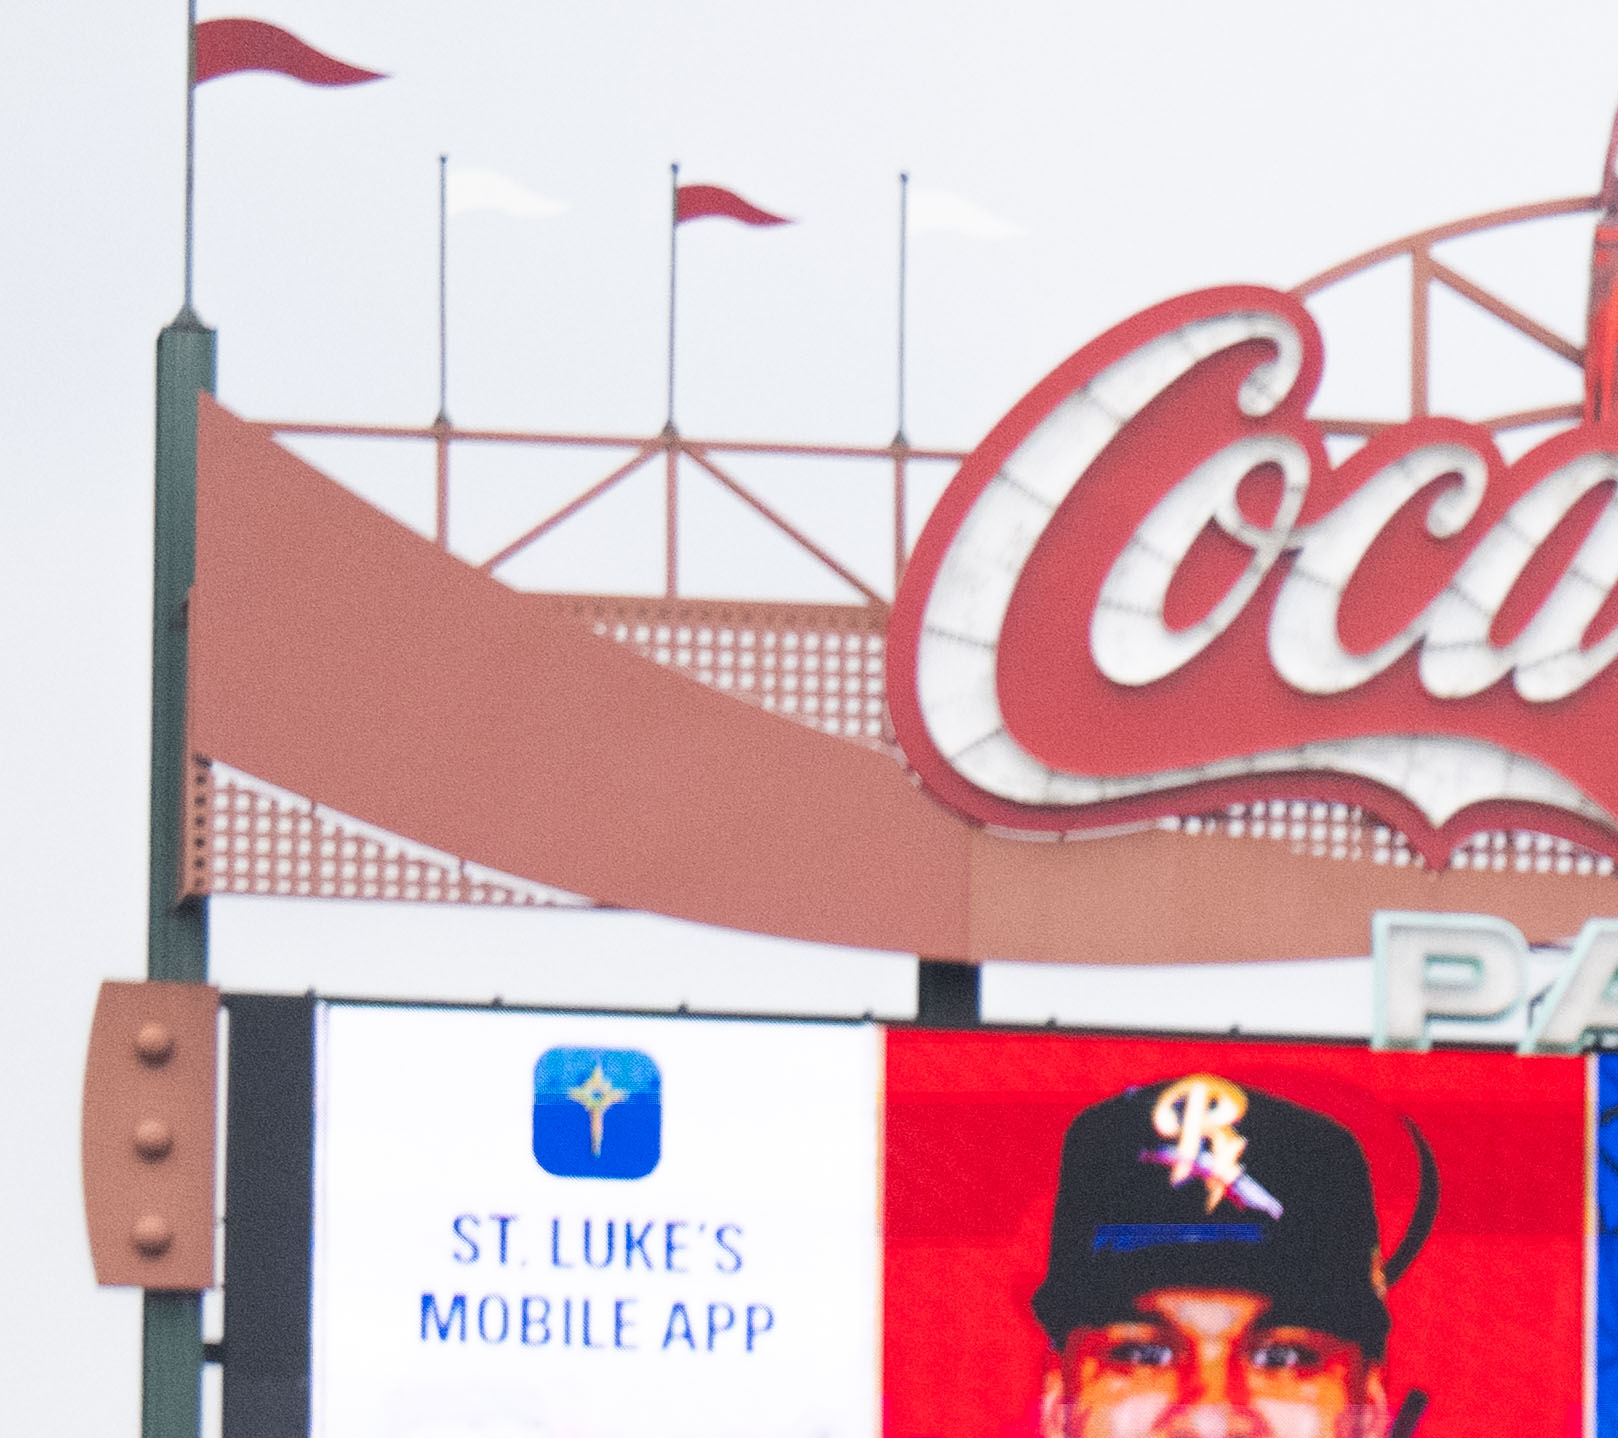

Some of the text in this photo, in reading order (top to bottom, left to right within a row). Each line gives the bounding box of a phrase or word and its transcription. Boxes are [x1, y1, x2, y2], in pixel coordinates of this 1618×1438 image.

[450, 1212, 745, 1275] ST. LUKE'S
[419, 1292, 776, 1354] MOBILE APP
